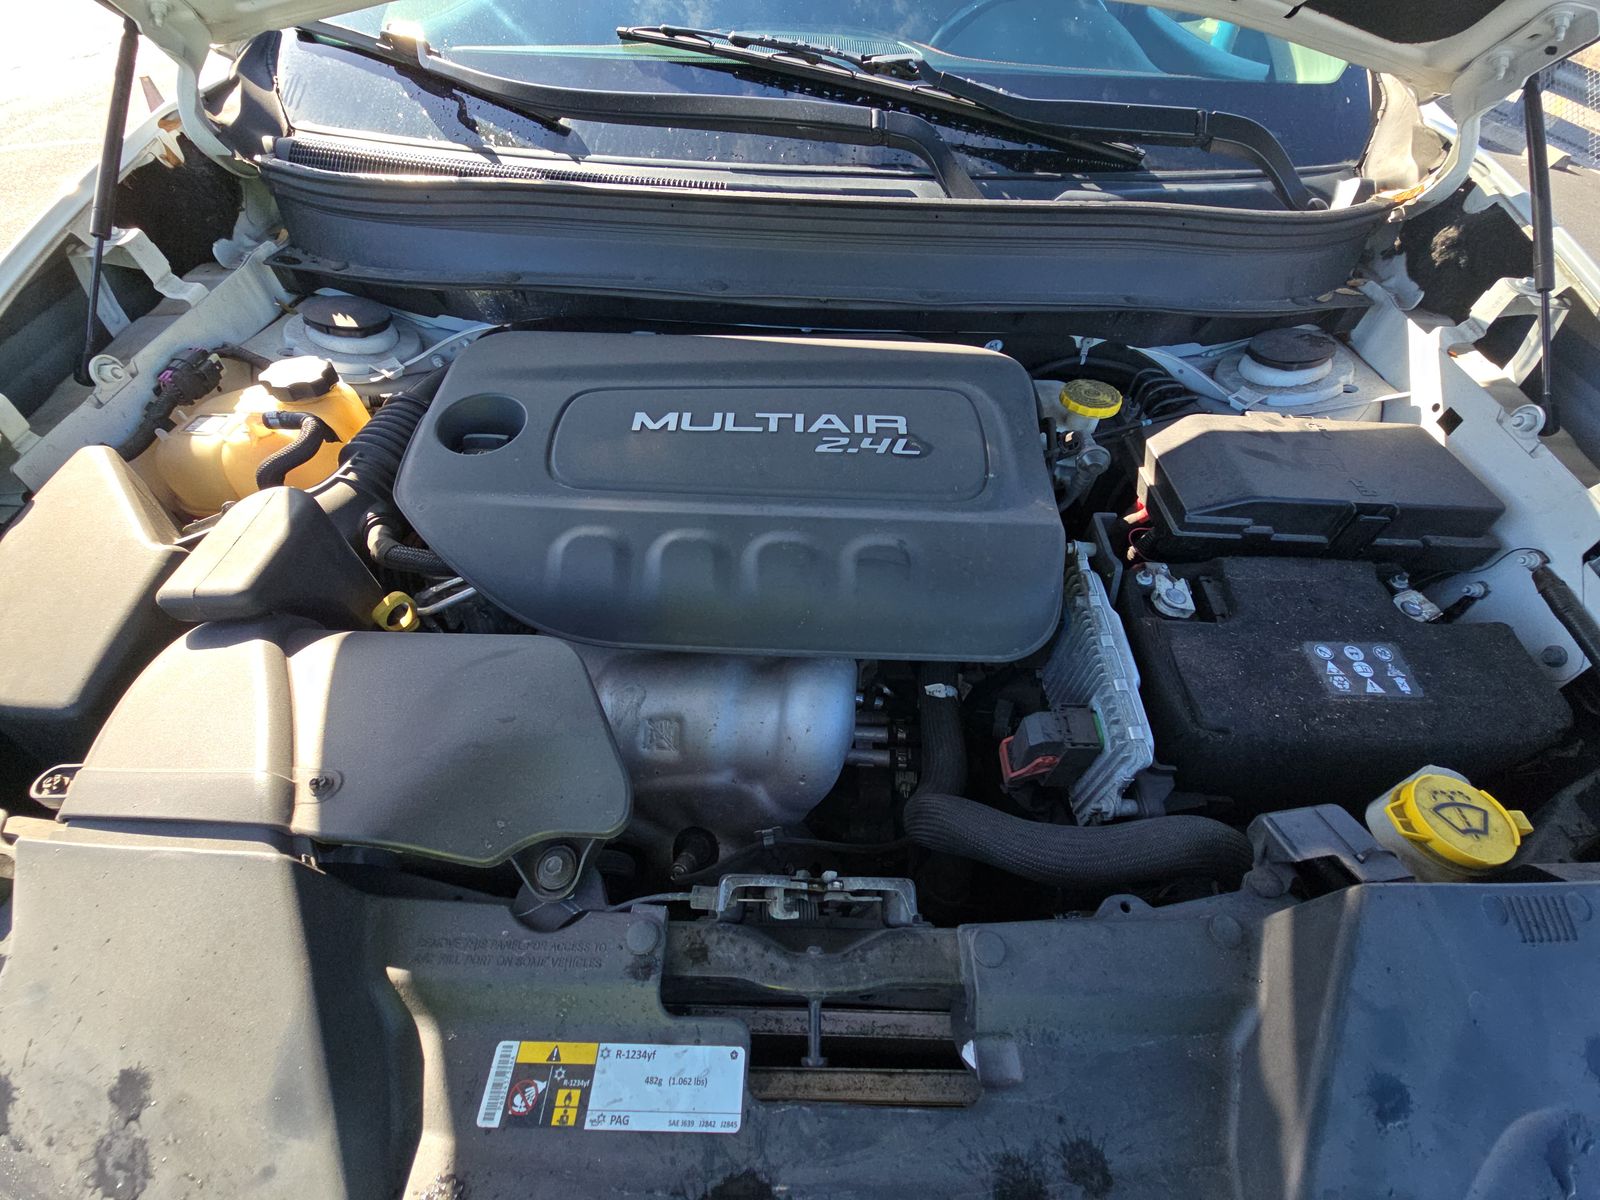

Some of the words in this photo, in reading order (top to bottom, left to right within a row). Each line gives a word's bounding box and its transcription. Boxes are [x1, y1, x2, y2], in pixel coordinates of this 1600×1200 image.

[631, 411, 907, 434] MULTIAIR
[814, 436, 921, 455] 2.4L
[551, 941, 591, 953] ACCESS
[594, 942, 608, 953] TO
[496, 955, 513, 967] ON
[551, 956, 603, 969] VEHICLES
[615, 1049, 657, 1062] R-1234yf
[563, 1079, 590, 1089] R-1234yf
[645, 1075, 663, 1087] 482g
[668, 1077, 693, 1087] (1.062
[693, 1077, 708, 1087] lbs)
[609, 1115, 630, 1126] PAG
[668, 1119, 680, 1127] SAE
